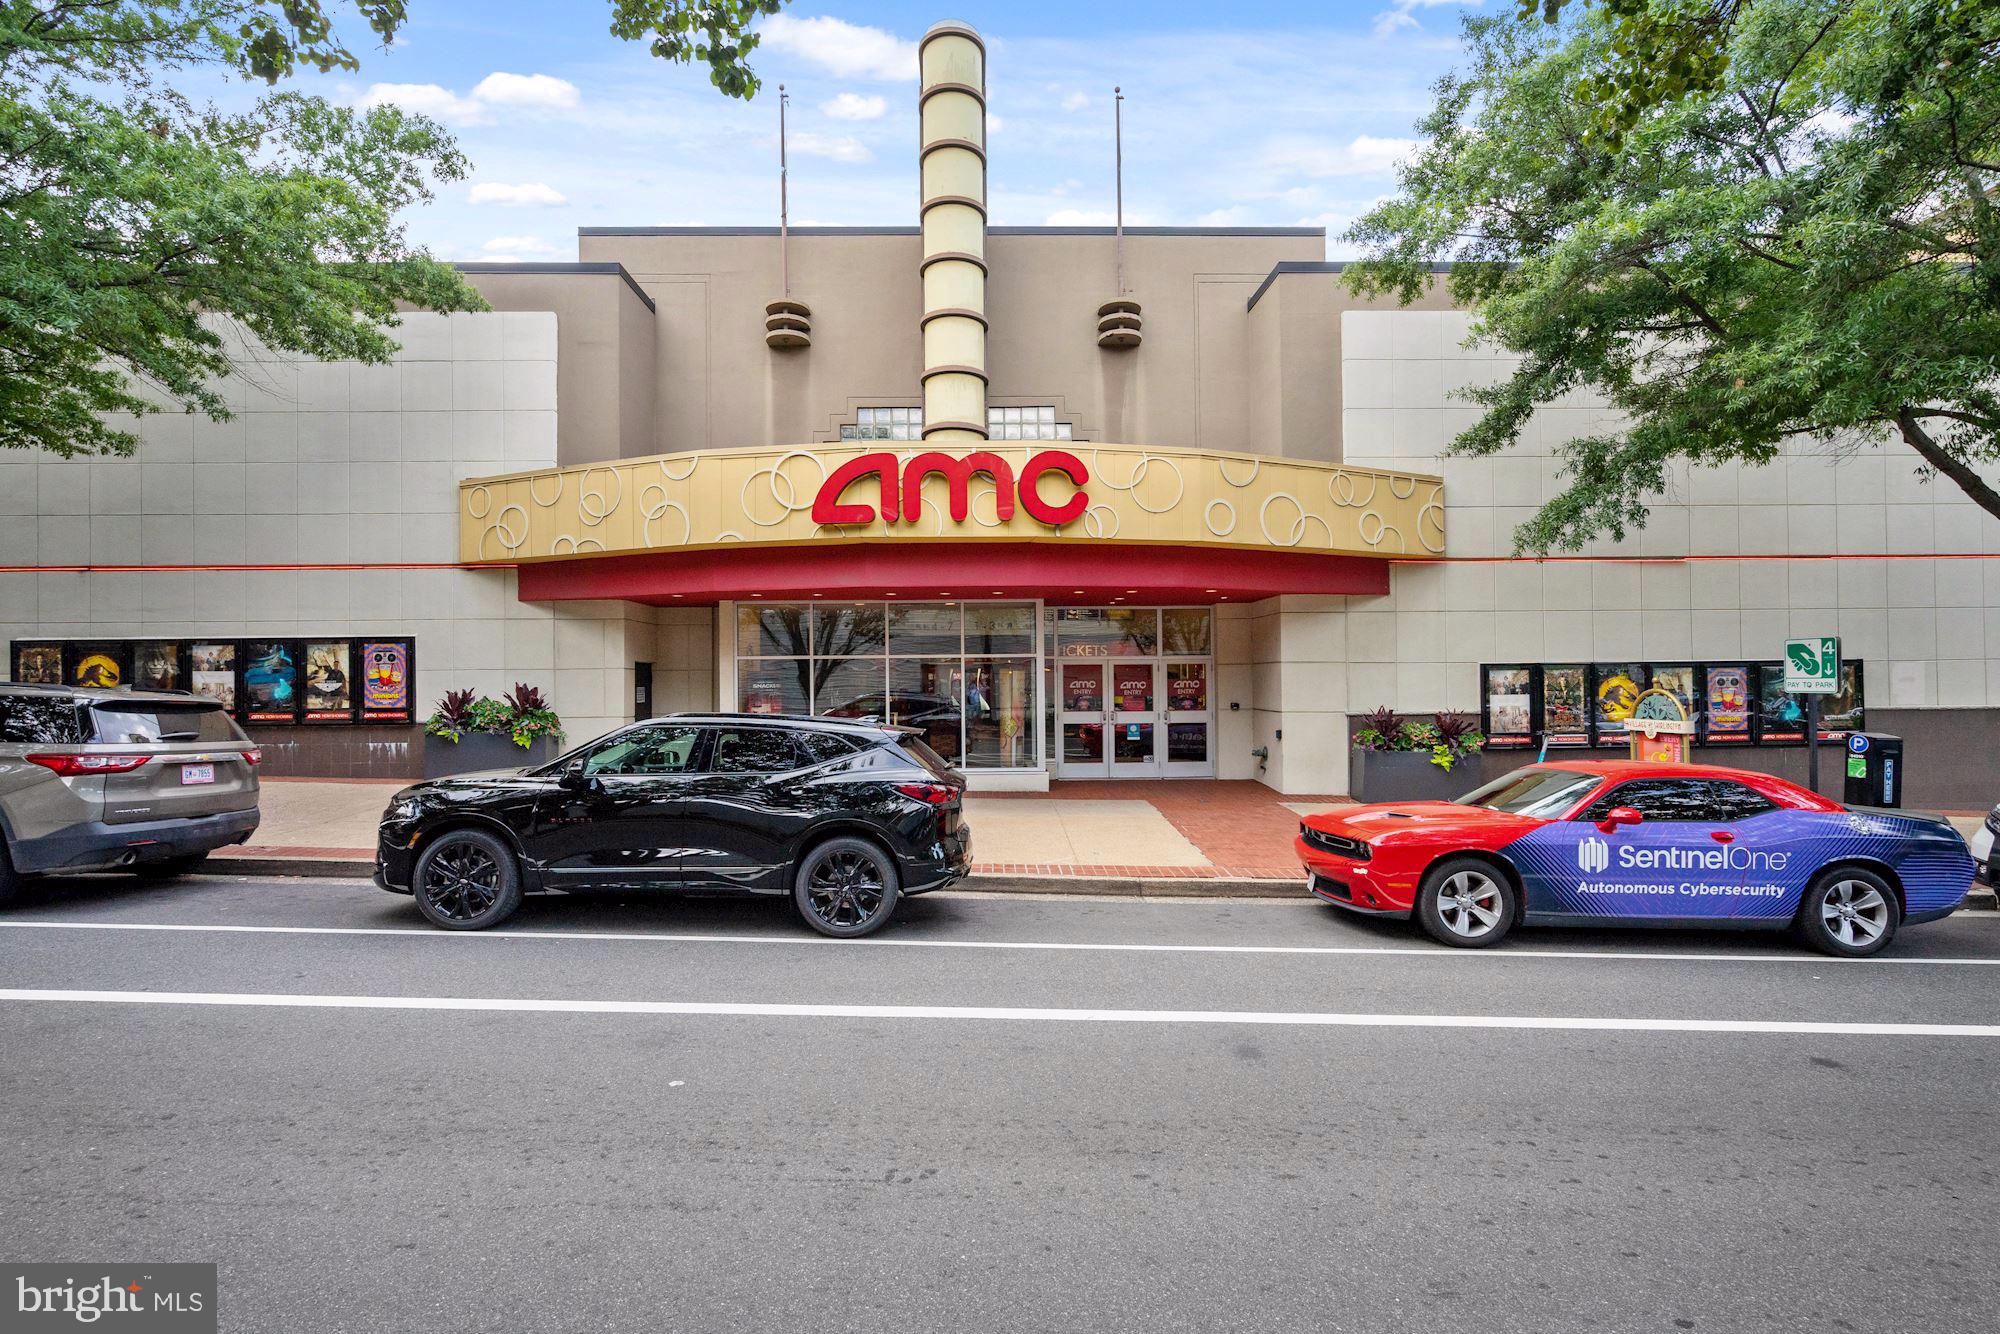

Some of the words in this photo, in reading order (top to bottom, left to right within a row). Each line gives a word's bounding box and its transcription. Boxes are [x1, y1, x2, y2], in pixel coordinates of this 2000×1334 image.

[811, 450, 1089, 526] amc
[1062, 644, 1108, 656] ICKETS
[1822, 641, 1835, 655] 4
[1070, 680, 1096, 689] amc
[1120, 680, 1147, 689] amc
[1173, 680, 1200, 688] amc
[1853, 737, 1864, 749] P
[1618, 844, 1787, 871] SentinelOne
[1577, 881, 1675, 895] Autonomous
[1679, 882, 1785, 898] Cybersecurity
